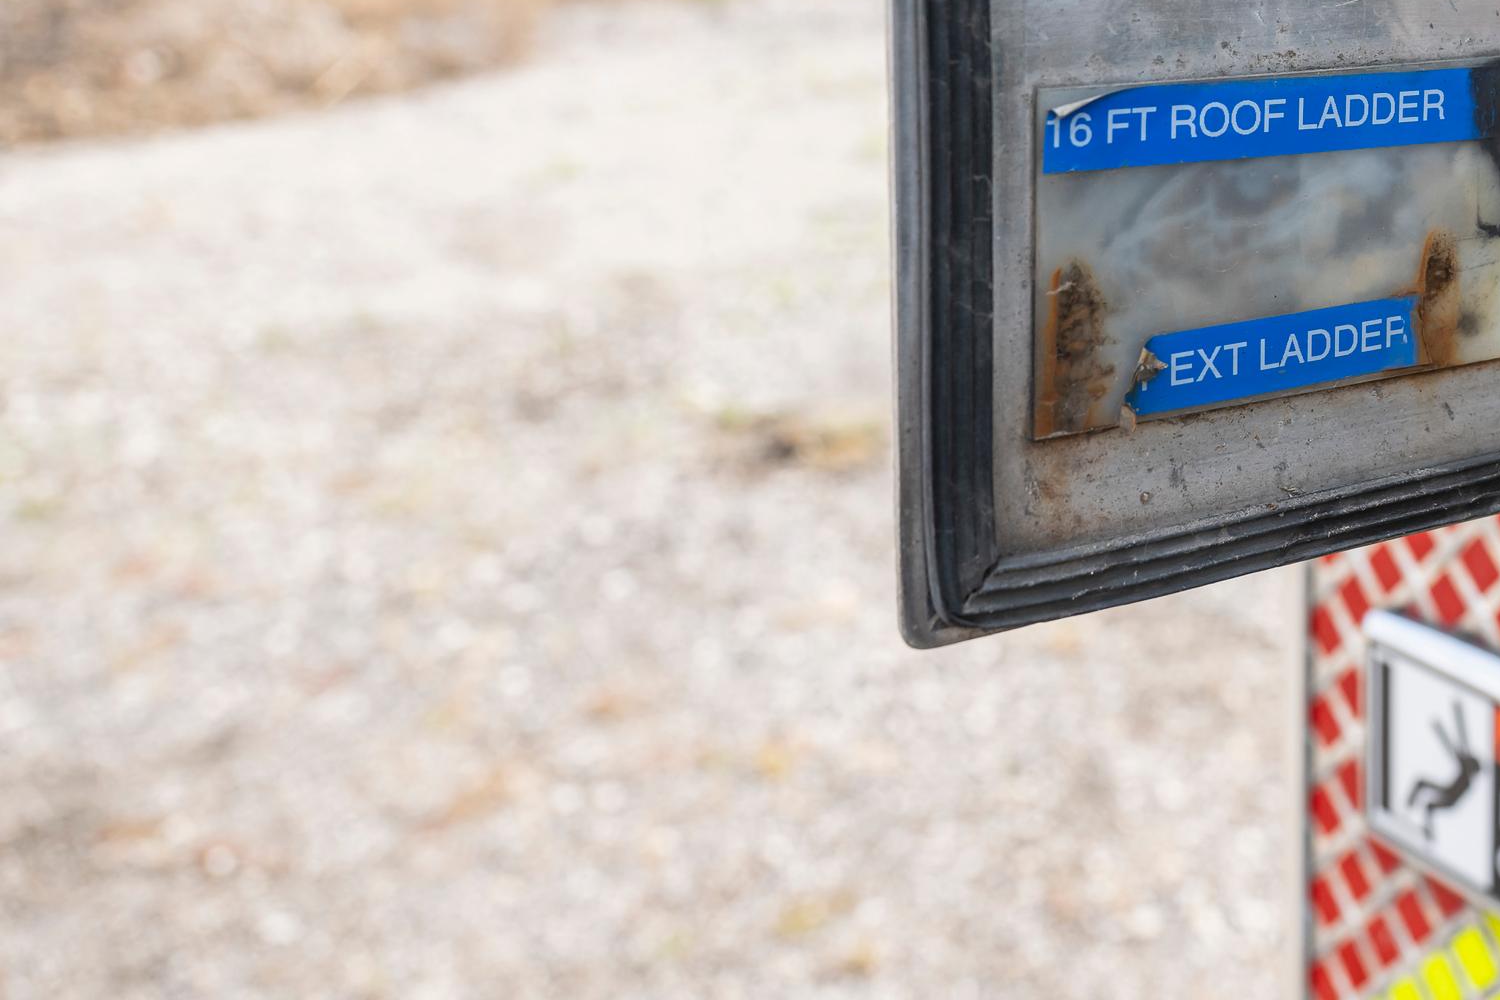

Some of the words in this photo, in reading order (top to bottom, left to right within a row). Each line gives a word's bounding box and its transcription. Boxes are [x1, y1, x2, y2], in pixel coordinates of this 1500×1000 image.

[1047, 112, 1093, 149] 16
[1106, 106, 1157, 145] FT
[1170, 99, 1287, 139] ROOF
[1298, 88, 1446, 131] LADDER
[1170, 341, 1248, 387] EXT
